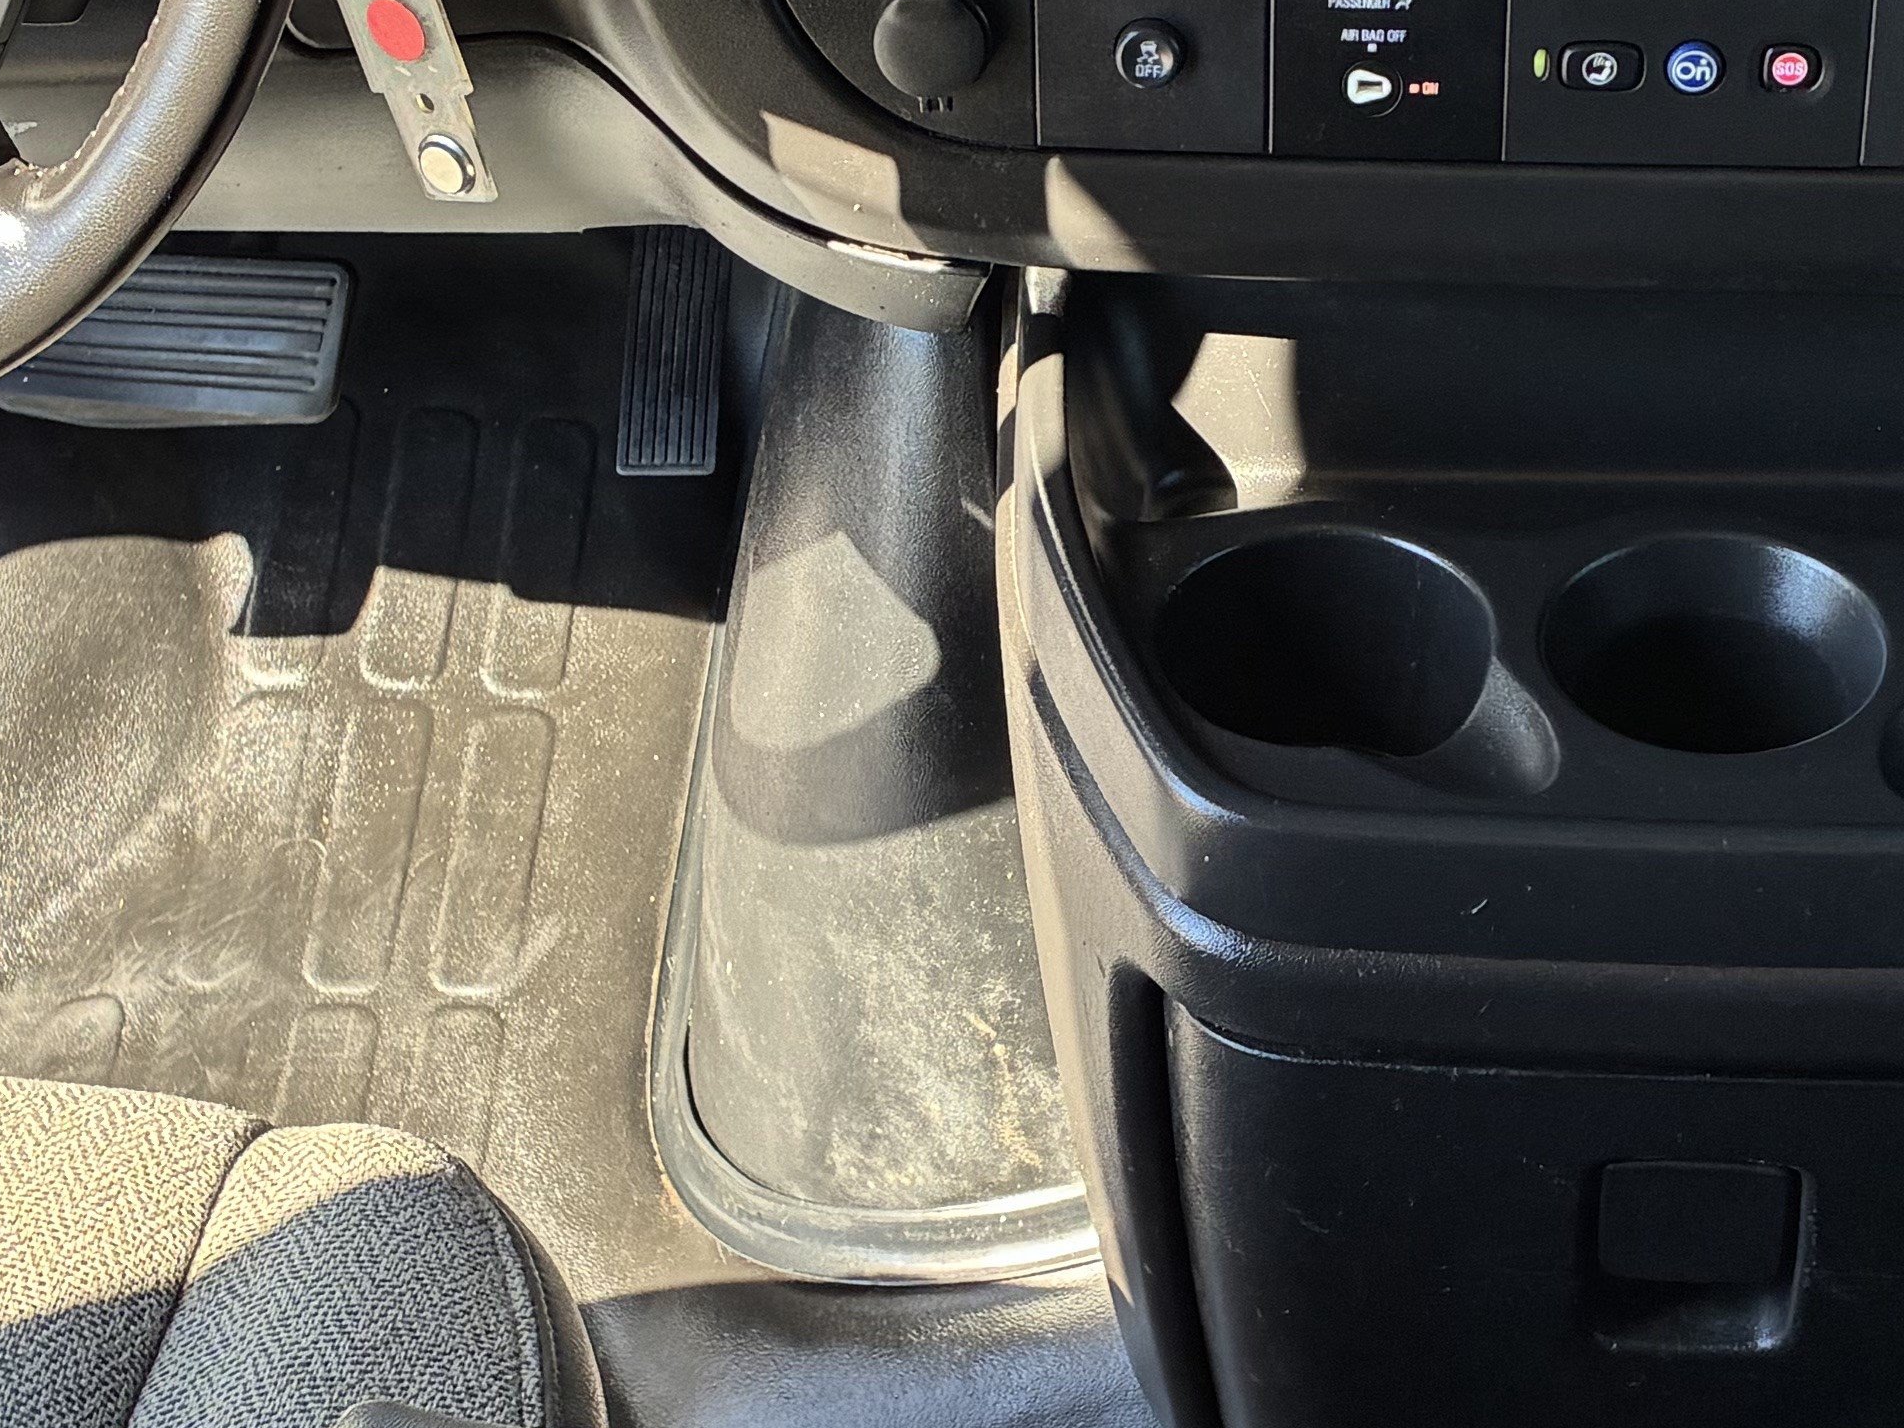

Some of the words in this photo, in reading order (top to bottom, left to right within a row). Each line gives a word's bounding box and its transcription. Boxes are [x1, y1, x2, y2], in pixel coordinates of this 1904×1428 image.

[1340, 28, 1359, 42] AIR
[1361, 29, 1385, 42] BAG
[1386, 29, 1407, 43] OFF
[1134, 64, 1162, 79] OFF
[1775, 61, 1805, 77] SOS
